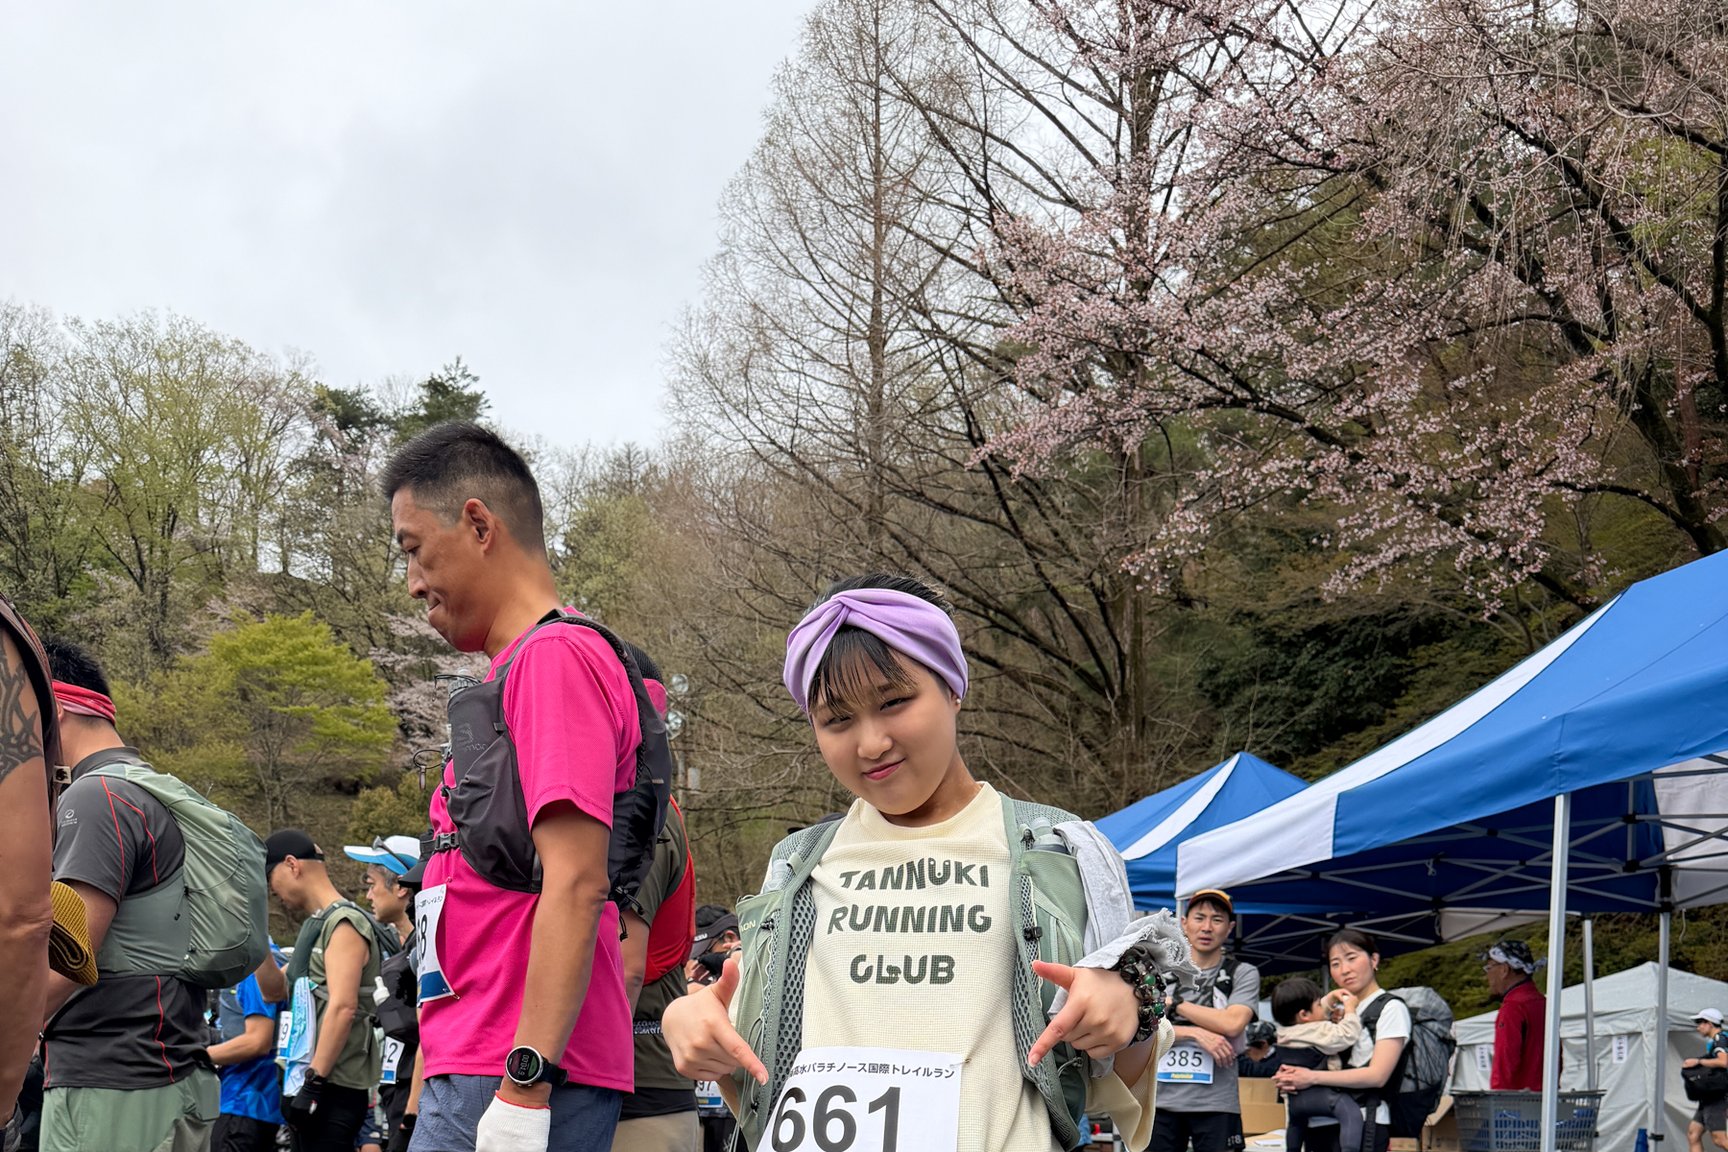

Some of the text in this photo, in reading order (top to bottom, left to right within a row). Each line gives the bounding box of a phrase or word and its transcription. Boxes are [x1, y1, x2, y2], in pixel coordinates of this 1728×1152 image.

[839, 857, 989, 890] TANNUKI
[827, 904, 992, 935] RUNNING
[850, 954, 956, 985] CLUB
[1167, 1050, 1203, 1068] 385
